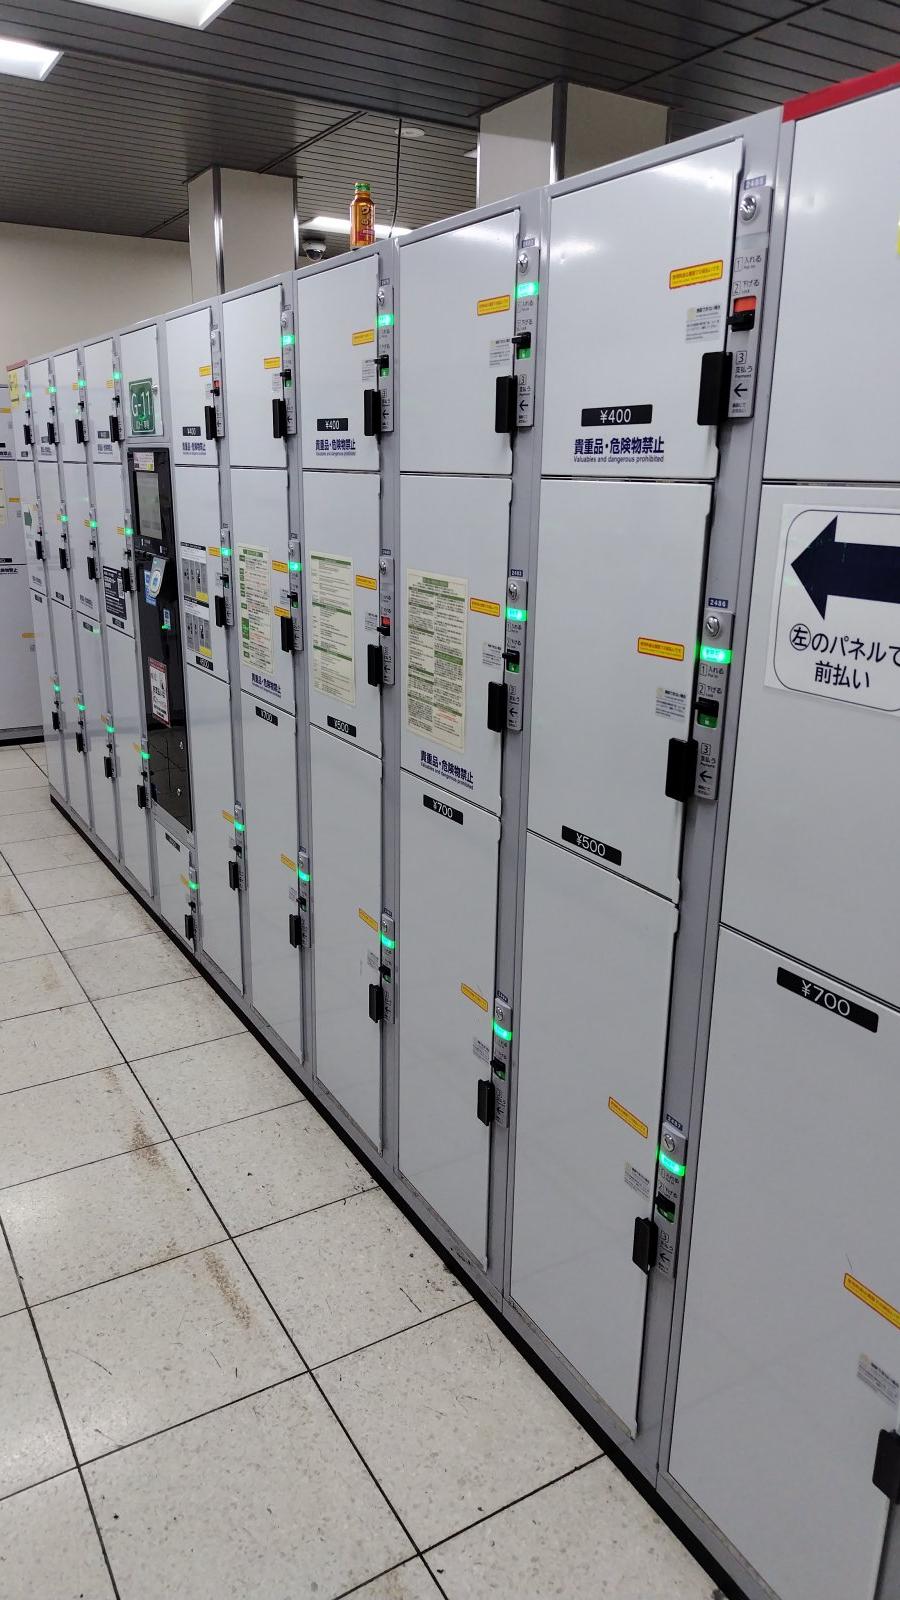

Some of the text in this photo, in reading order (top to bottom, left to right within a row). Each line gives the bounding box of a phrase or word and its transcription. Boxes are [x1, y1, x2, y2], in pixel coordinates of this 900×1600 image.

[131, 391, 152, 417] G-11
[600, 408, 631, 423] ¥400
[608, 455, 635, 464] dangerous
[636, 455, 664, 464] prohibited
[815, 660, 870, 690] 前払い
[432, 799, 453, 819] ¥700
[576, 832, 606, 857] ¥500
[801, 980, 851, 1016] ¥700
